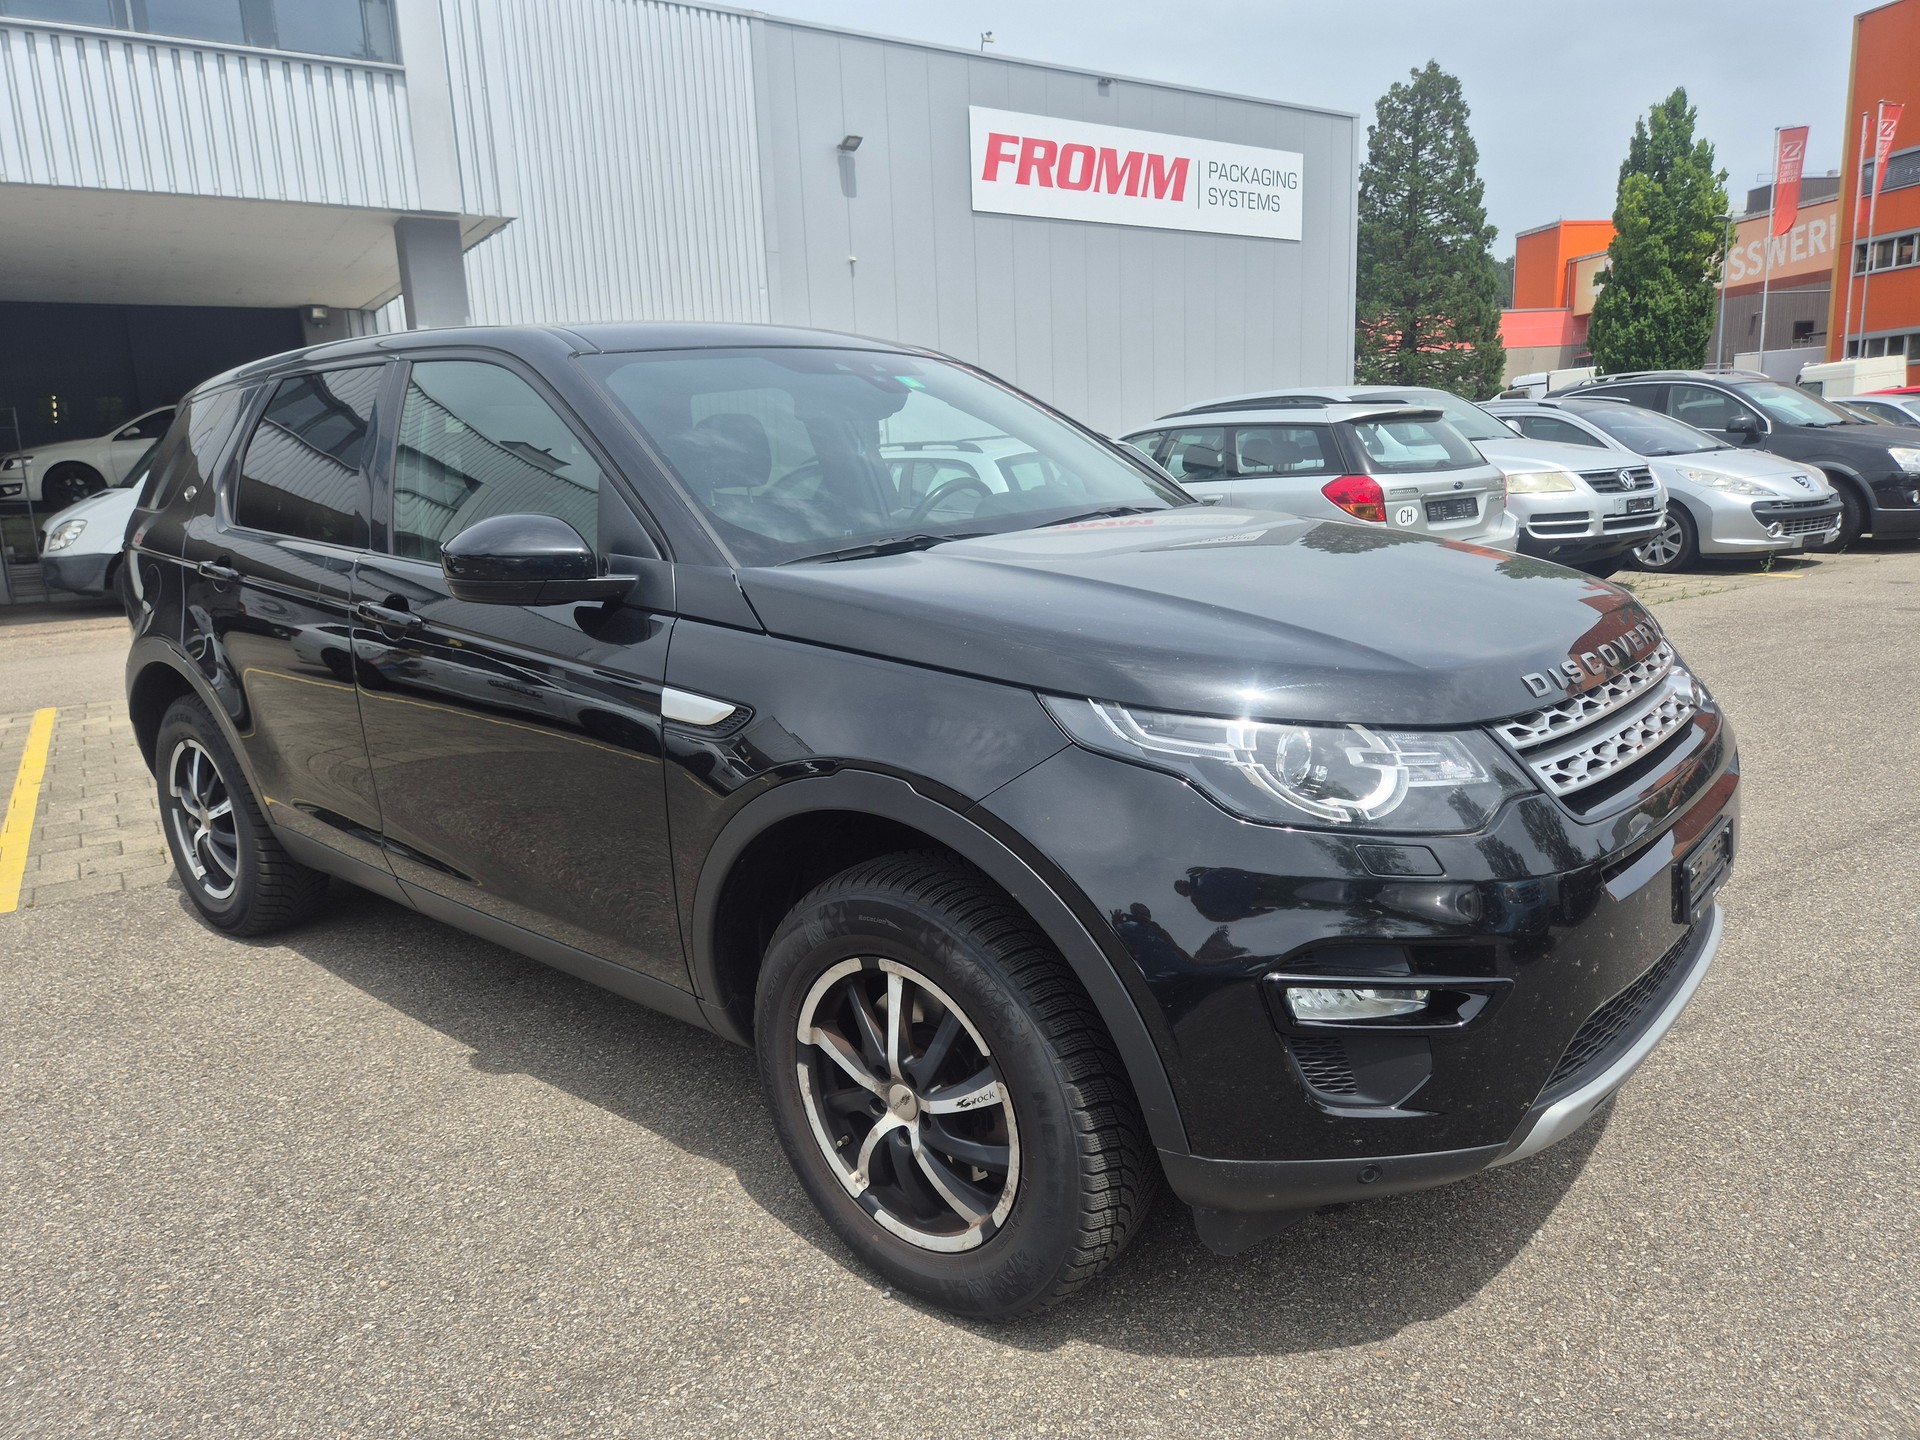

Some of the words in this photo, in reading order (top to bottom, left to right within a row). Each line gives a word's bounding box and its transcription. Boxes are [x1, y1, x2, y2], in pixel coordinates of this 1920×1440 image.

[981, 132, 1190, 202] FROMM
[1208, 161, 1298, 190] PACKAGING
[1208, 187, 1281, 213] SYSTEMS
[1400, 509, 1413, 523] CH
